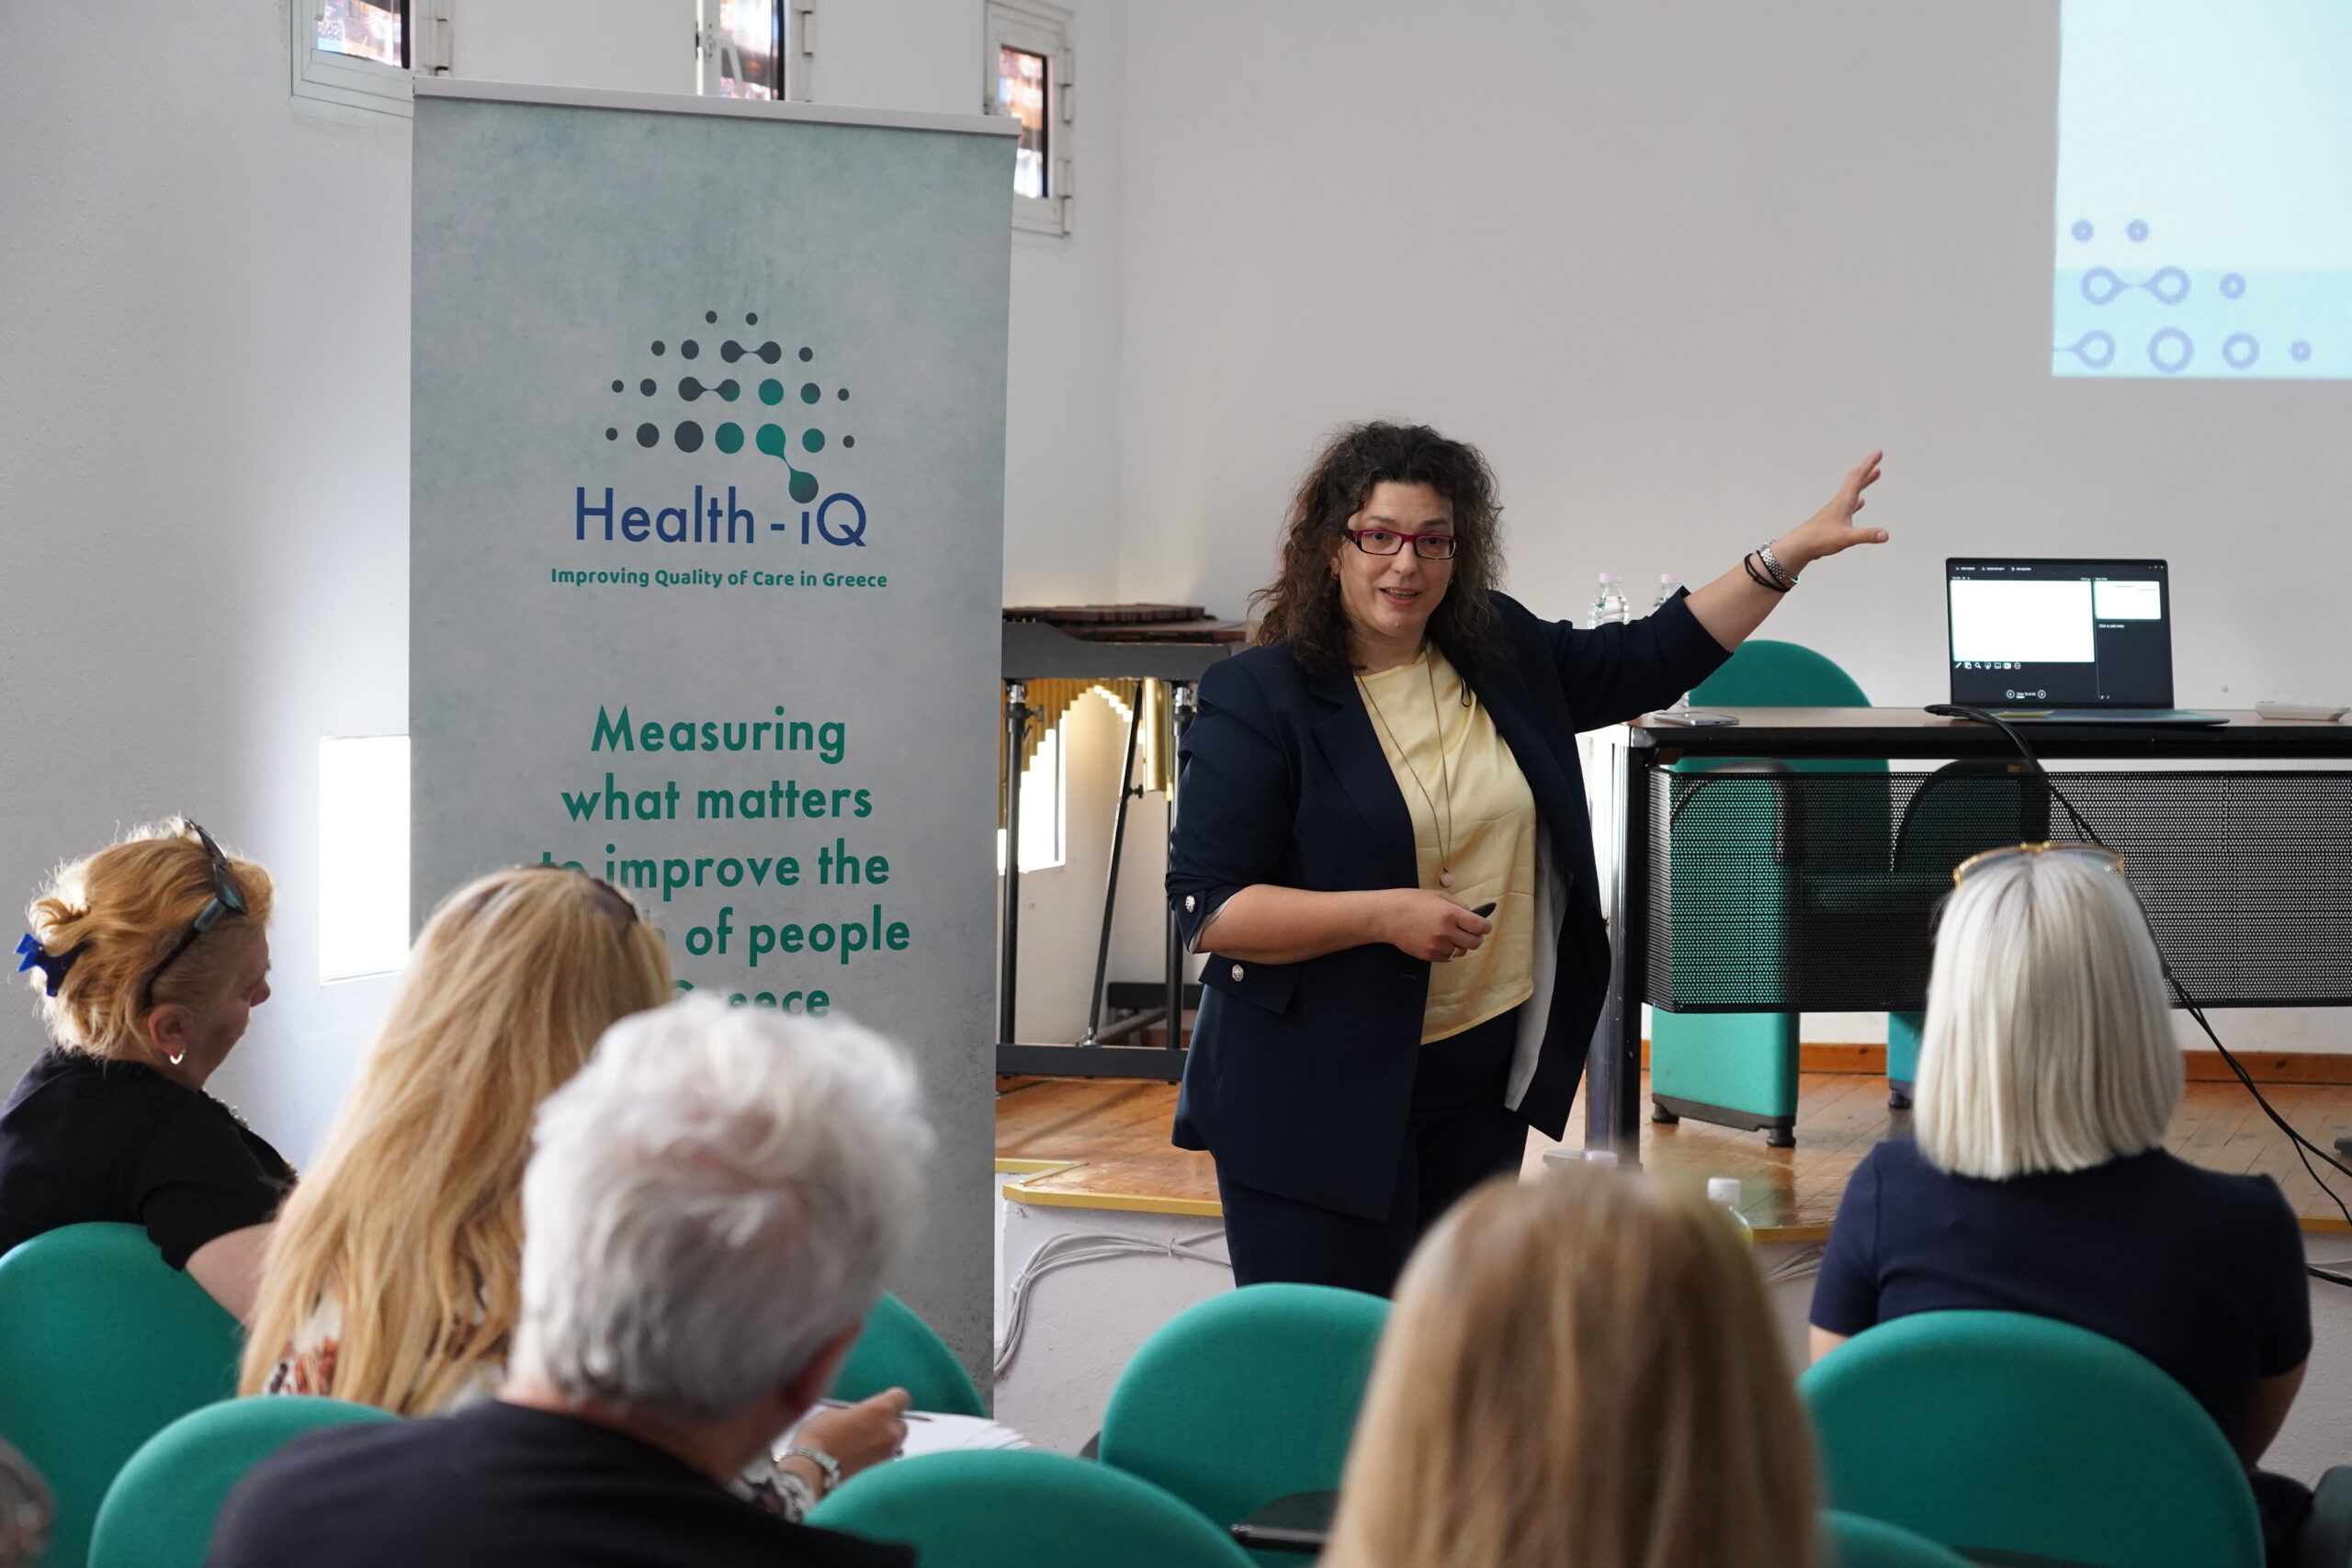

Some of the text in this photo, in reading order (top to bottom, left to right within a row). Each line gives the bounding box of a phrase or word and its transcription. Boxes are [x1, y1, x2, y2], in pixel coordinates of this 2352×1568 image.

[575, 484, 755, 545] Health
[550, 568, 888, 589] Improving Quality of Care in Greece
[591, 704, 846, 765] Measuring
[560, 773, 873, 822] what matters
[605, 843, 800, 902] improve
[818, 837, 890, 886] the
[685, 906, 734, 956] of
[749, 903, 910, 968] people
[674, 979, 831, 1018] eece
